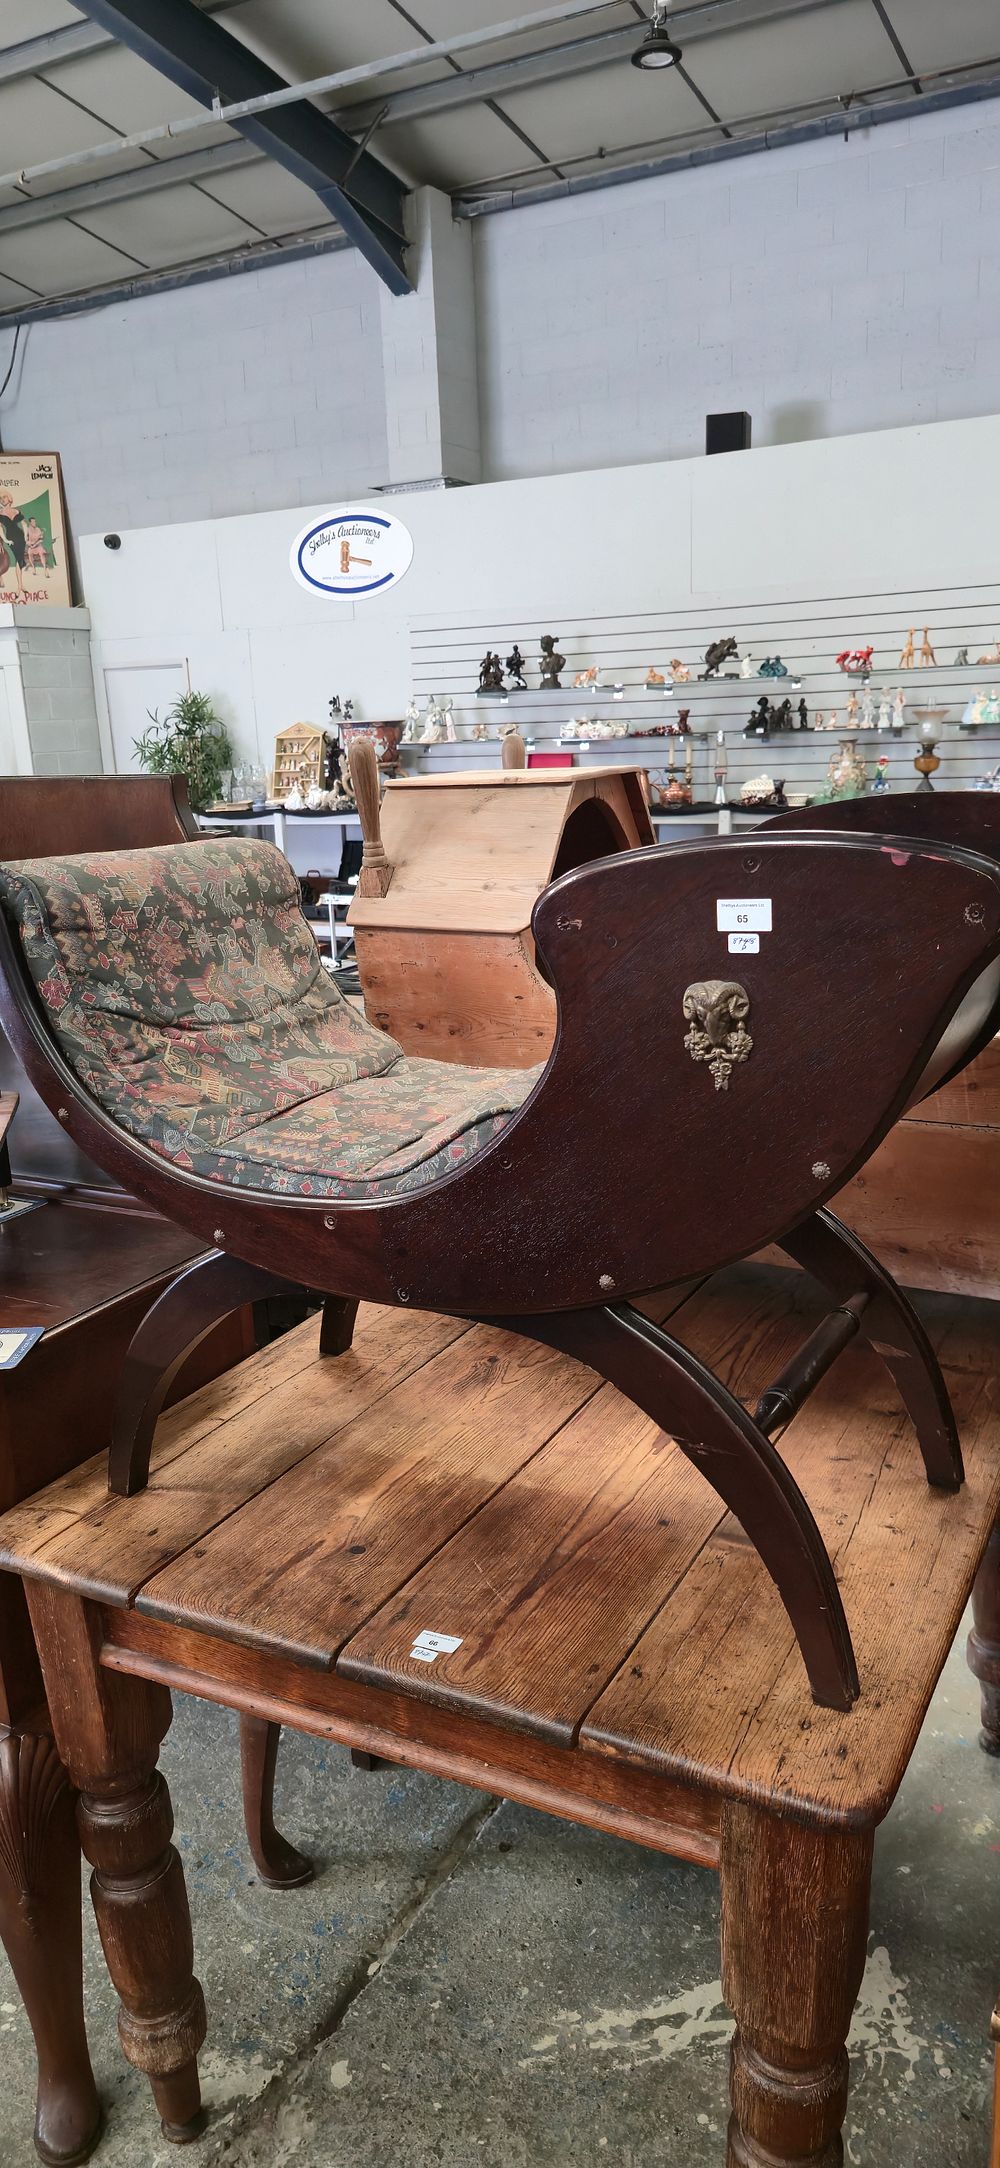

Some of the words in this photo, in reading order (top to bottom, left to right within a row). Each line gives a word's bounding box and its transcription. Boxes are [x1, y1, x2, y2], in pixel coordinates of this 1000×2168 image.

[338, 523, 381, 539] Auctioneers
[25, 589, 48, 602] PIACE
[737, 914, 748, 923] 65
